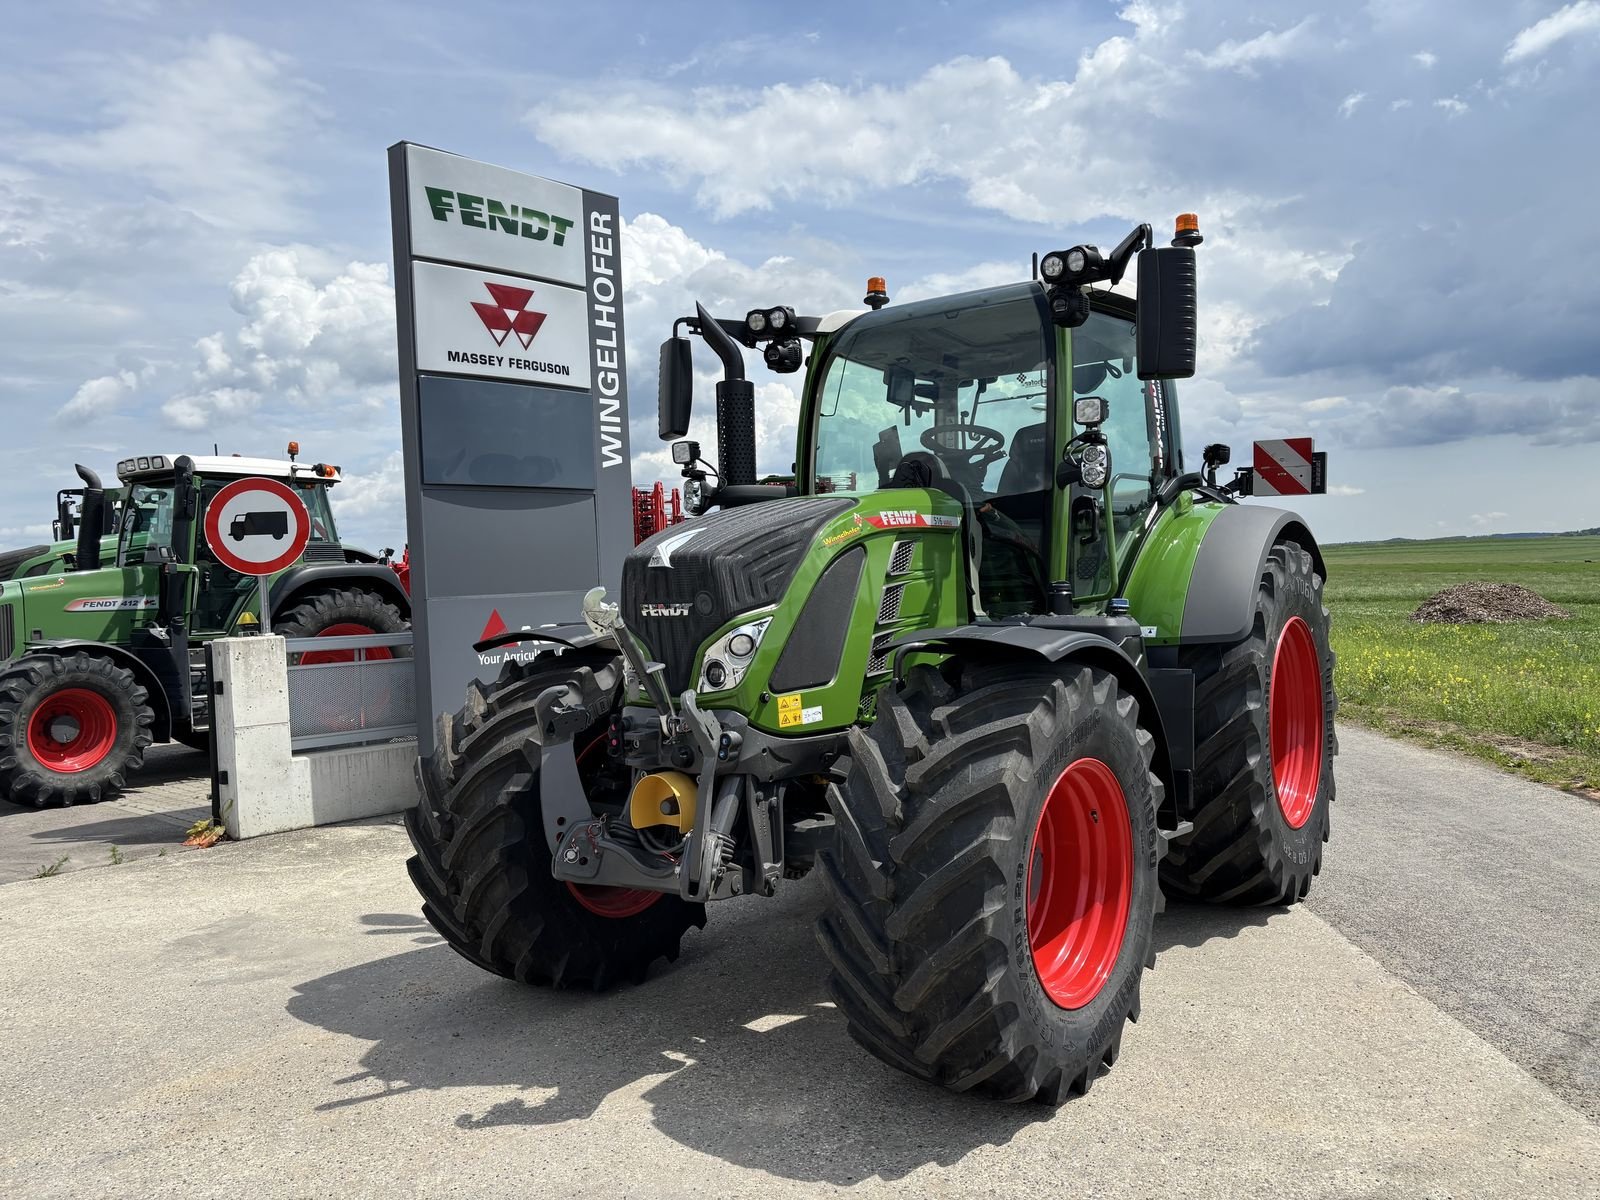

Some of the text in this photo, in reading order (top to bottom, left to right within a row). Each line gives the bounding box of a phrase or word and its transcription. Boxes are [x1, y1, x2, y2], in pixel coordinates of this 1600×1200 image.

[424, 186, 575, 247] FENDT
[591, 211, 623, 468] WINGELHOFER
[447, 350, 570, 376] MASSEY FERGUSON
[879, 509, 917, 526] FENDT
[641, 602, 694, 617] FENDT
[477, 654, 501, 665] Your
